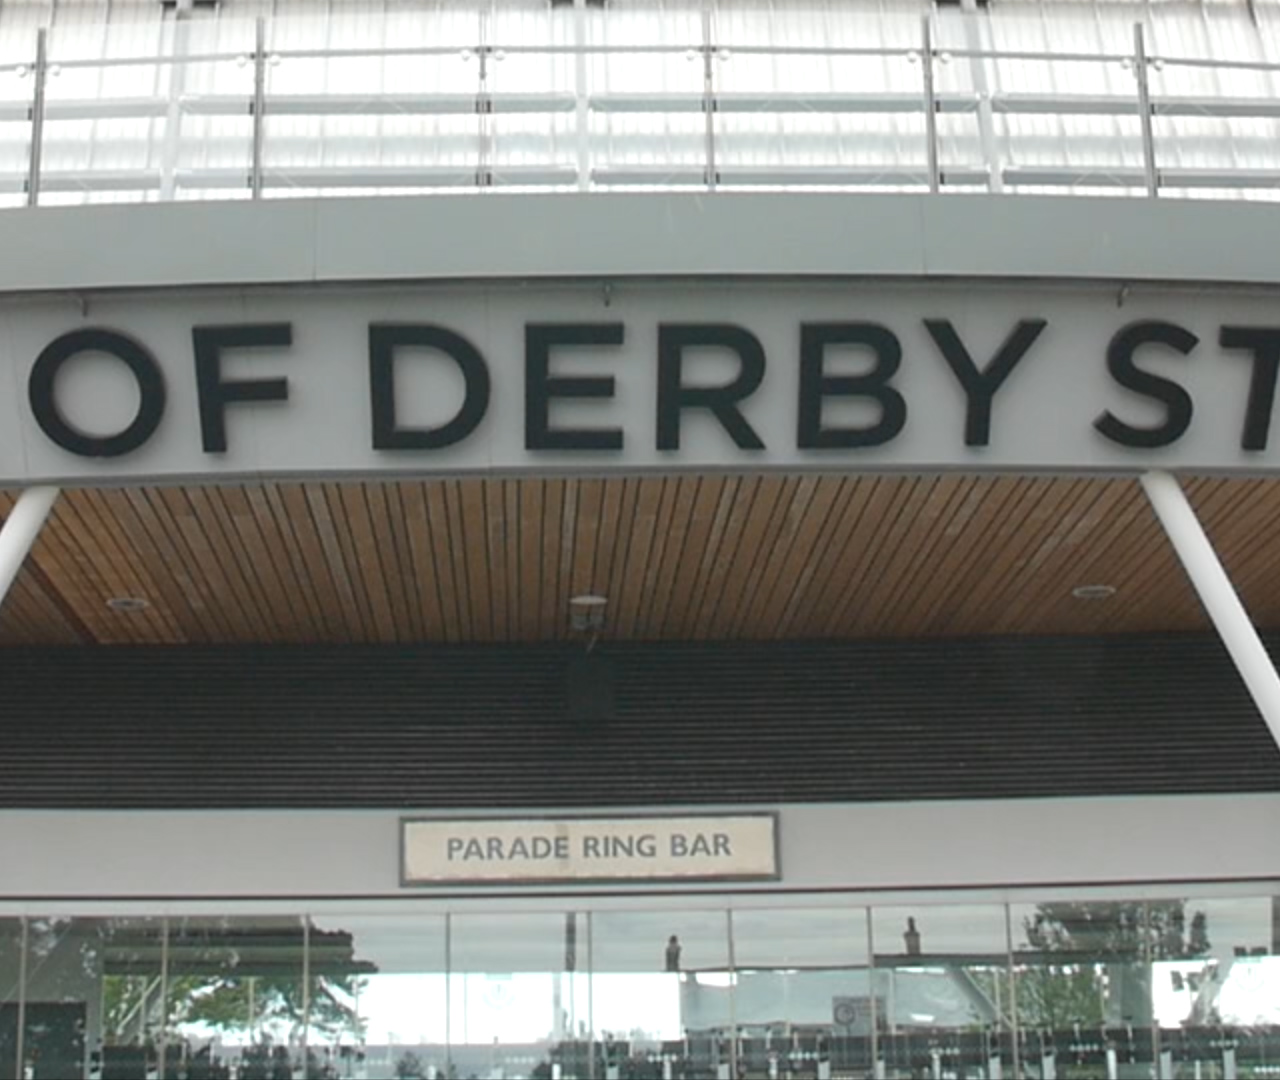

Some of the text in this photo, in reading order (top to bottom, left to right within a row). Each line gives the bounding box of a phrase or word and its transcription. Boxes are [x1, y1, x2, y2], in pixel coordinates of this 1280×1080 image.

[28, 324, 293, 458] OF
[367, 320, 1049, 452] DERBY
[447, 834, 732, 860] PARADE RING BAR
